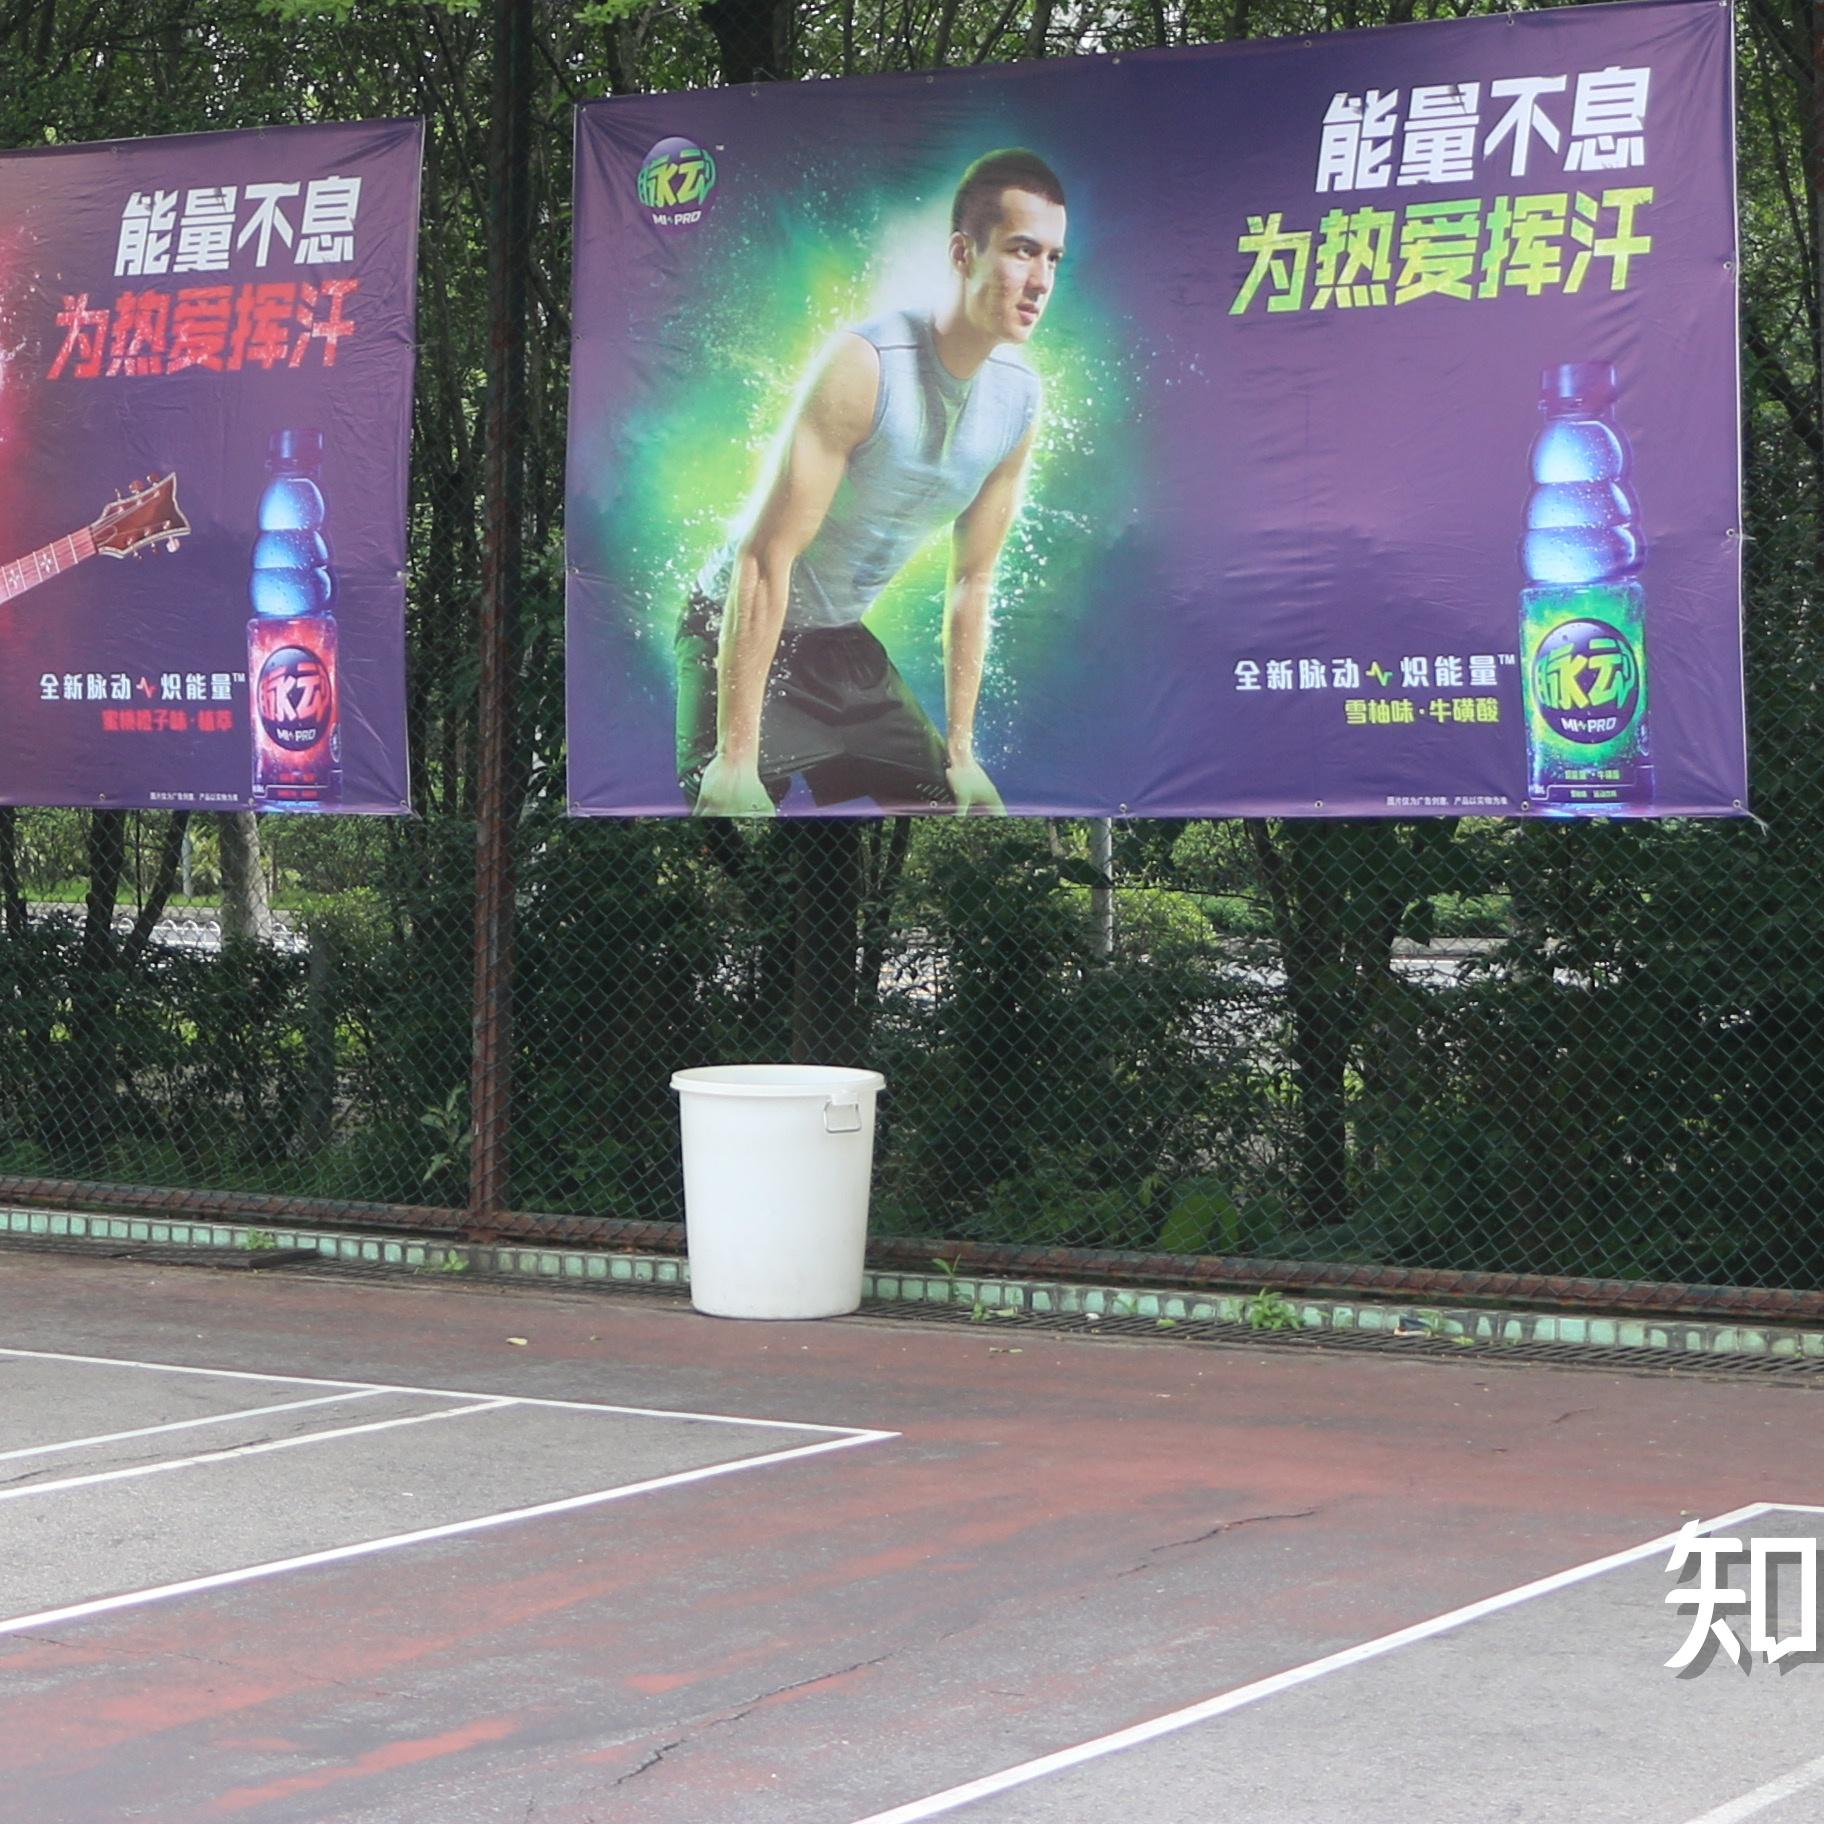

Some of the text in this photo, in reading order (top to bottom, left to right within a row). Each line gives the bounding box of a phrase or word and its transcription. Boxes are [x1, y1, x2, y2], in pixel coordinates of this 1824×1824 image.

[1315, 65, 1651, 193] 能量不息
[114, 176, 362, 276] 能量不息
[1228, 186, 1654, 315] 为热爱挥汗
[47, 278, 360, 380] 为热爱挥汗
